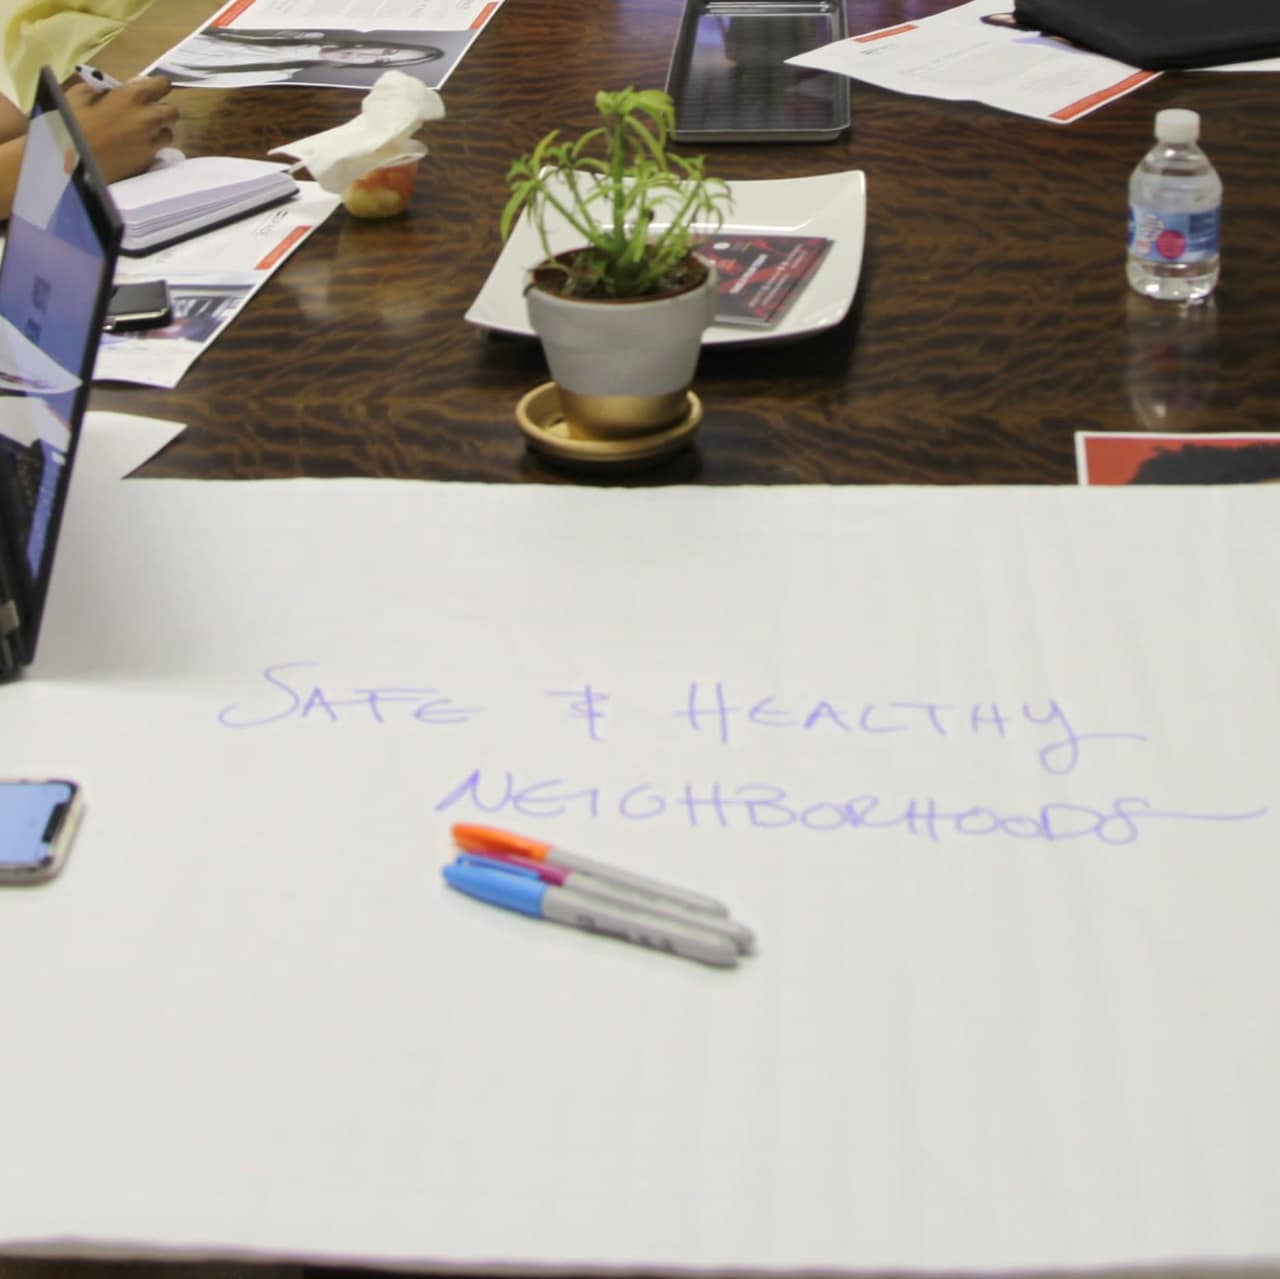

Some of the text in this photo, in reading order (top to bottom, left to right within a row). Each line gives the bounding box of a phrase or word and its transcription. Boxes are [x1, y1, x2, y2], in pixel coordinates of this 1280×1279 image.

[217, 661, 487, 729] SAFE
[673, 682, 1147, 775] HEALTHY
[434, 768, 1268, 845] NEIGHBORHOODS
